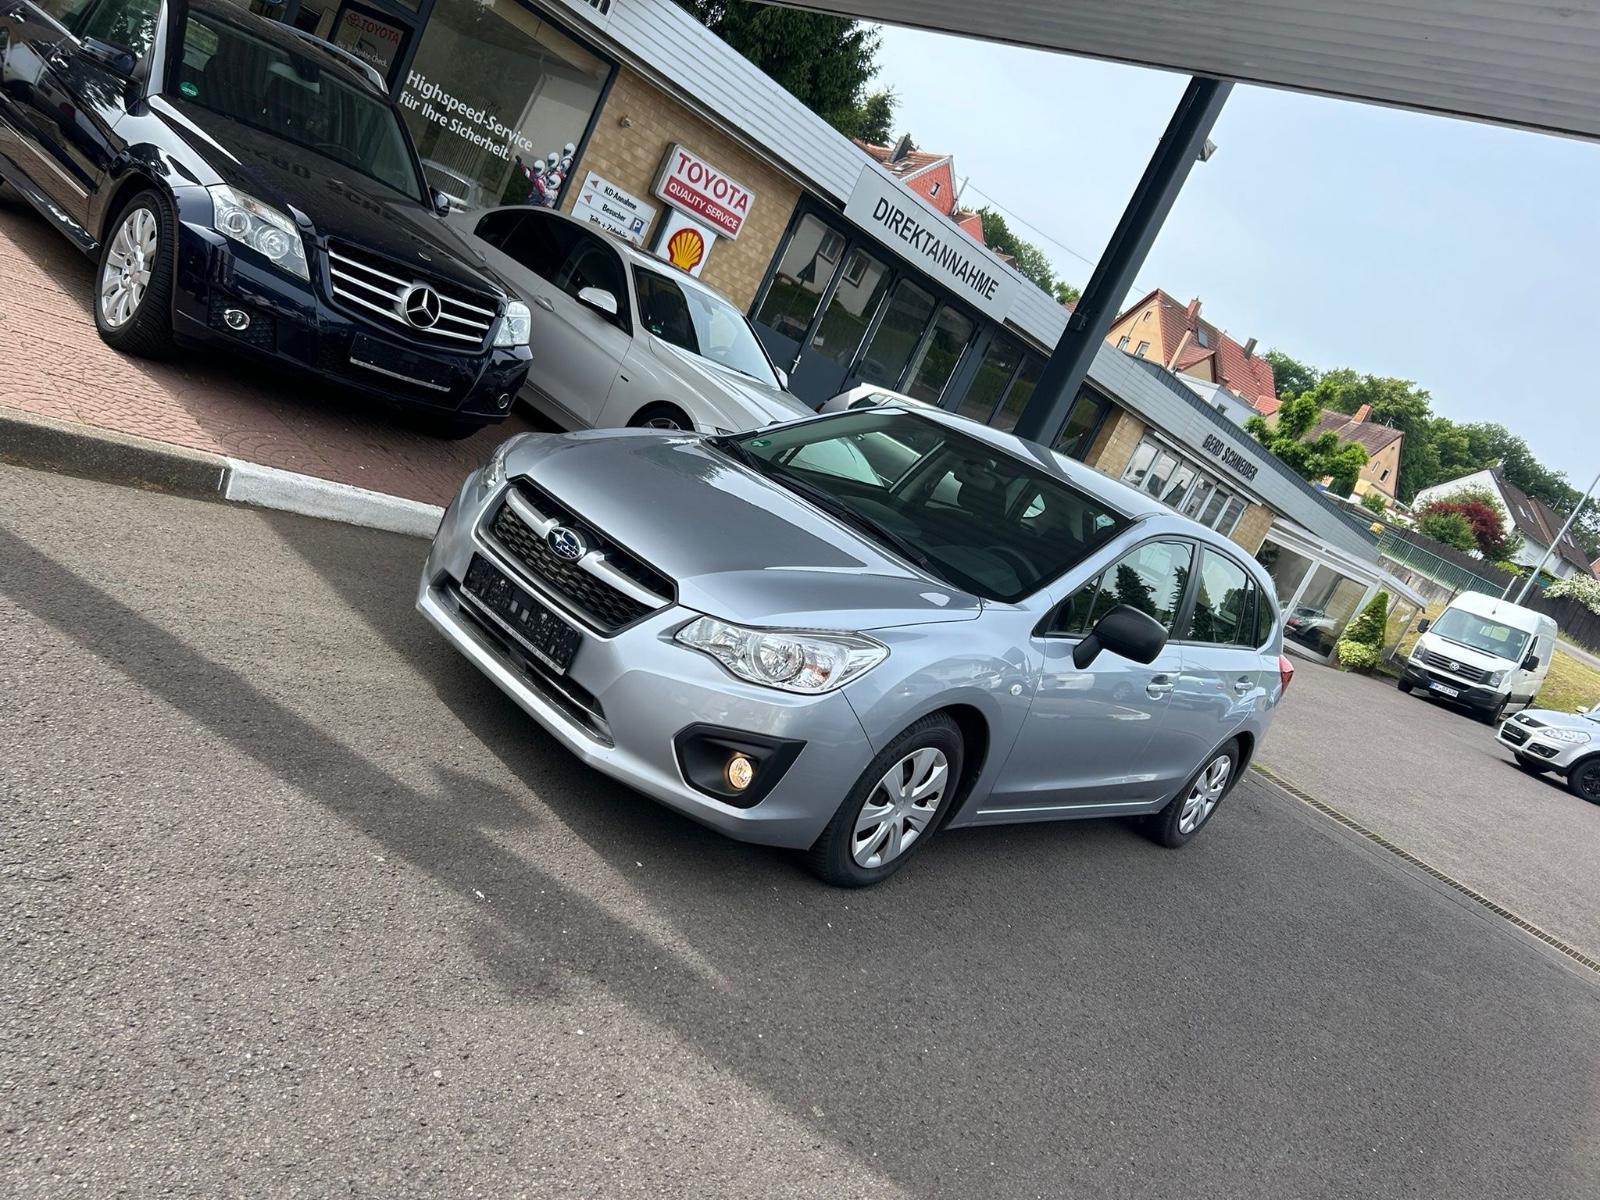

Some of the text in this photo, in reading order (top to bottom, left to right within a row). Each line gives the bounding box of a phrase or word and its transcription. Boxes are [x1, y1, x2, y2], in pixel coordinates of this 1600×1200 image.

[362, 19, 400, 44] TOYOTA
[399, 91, 510, 161] für Ihre Sicherheit.
[406, 70, 533, 152] Highspeed-Service
[669, 182, 739, 230] QUALITY SERVICE
[677, 152, 748, 214] TOYOTA
[602, 203, 627, 223] Besucher
[873, 196, 999, 301] DIREKTANNAHME
[1202, 433, 1259, 481] GERD SCHNEIDER
